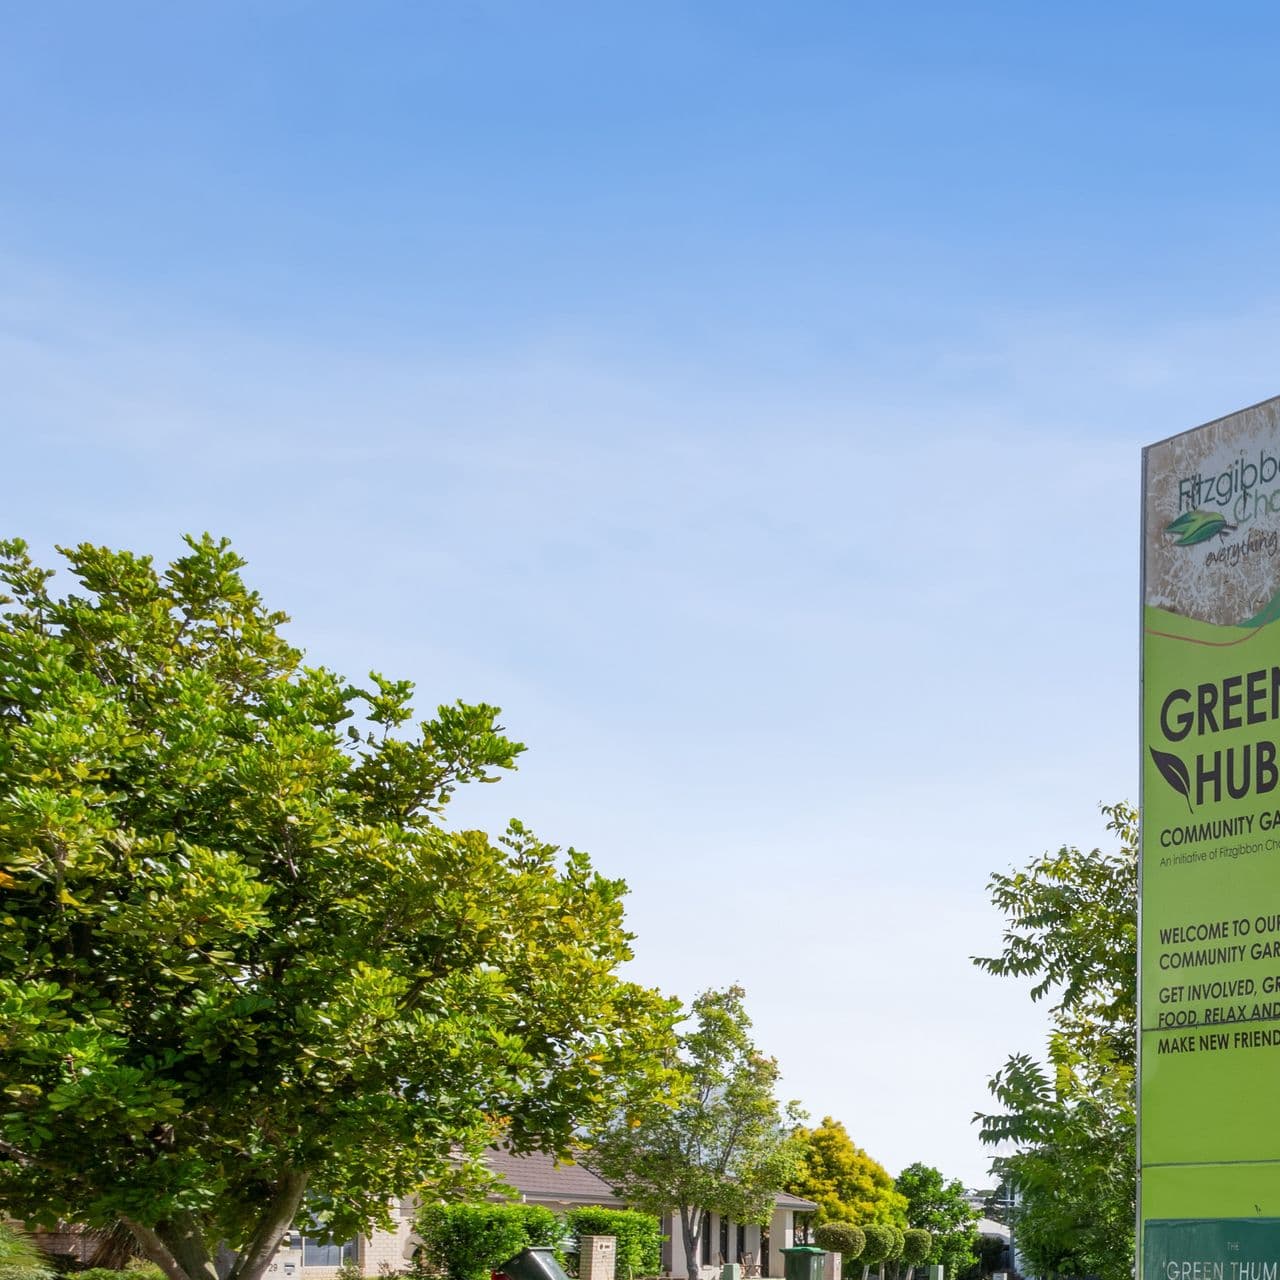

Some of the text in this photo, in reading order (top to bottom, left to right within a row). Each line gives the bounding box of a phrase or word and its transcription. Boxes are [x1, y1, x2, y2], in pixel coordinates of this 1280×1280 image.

[1205, 529, 1279, 567] everything
[1196, 741, 1279, 805] HUB
[1160, 815, 1254, 848] COMMUNITY
[1160, 857, 1172, 867] An
[1173, 850, 1207, 865] initiative
[1209, 849, 1219, 860] of
[1220, 842, 1263, 858] Fitzgibbon
[1159, 921, 1229, 945] WELCOME
[1232, 918, 1250, 937] TO
[1159, 945, 1246, 970] COMMUNITY
[1159, 987, 1184, 1004] GET
[1188, 979, 1257, 1001] INVOLVED,
[1158, 1010, 1200, 1028] FOOD,
[1204, 1005, 1247, 1024] RELAX
[1158, 1036, 1195, 1054] MAKE
[1200, 1033, 1230, 1051] NEW
[1227, 1241, 1240, 1251] THE
